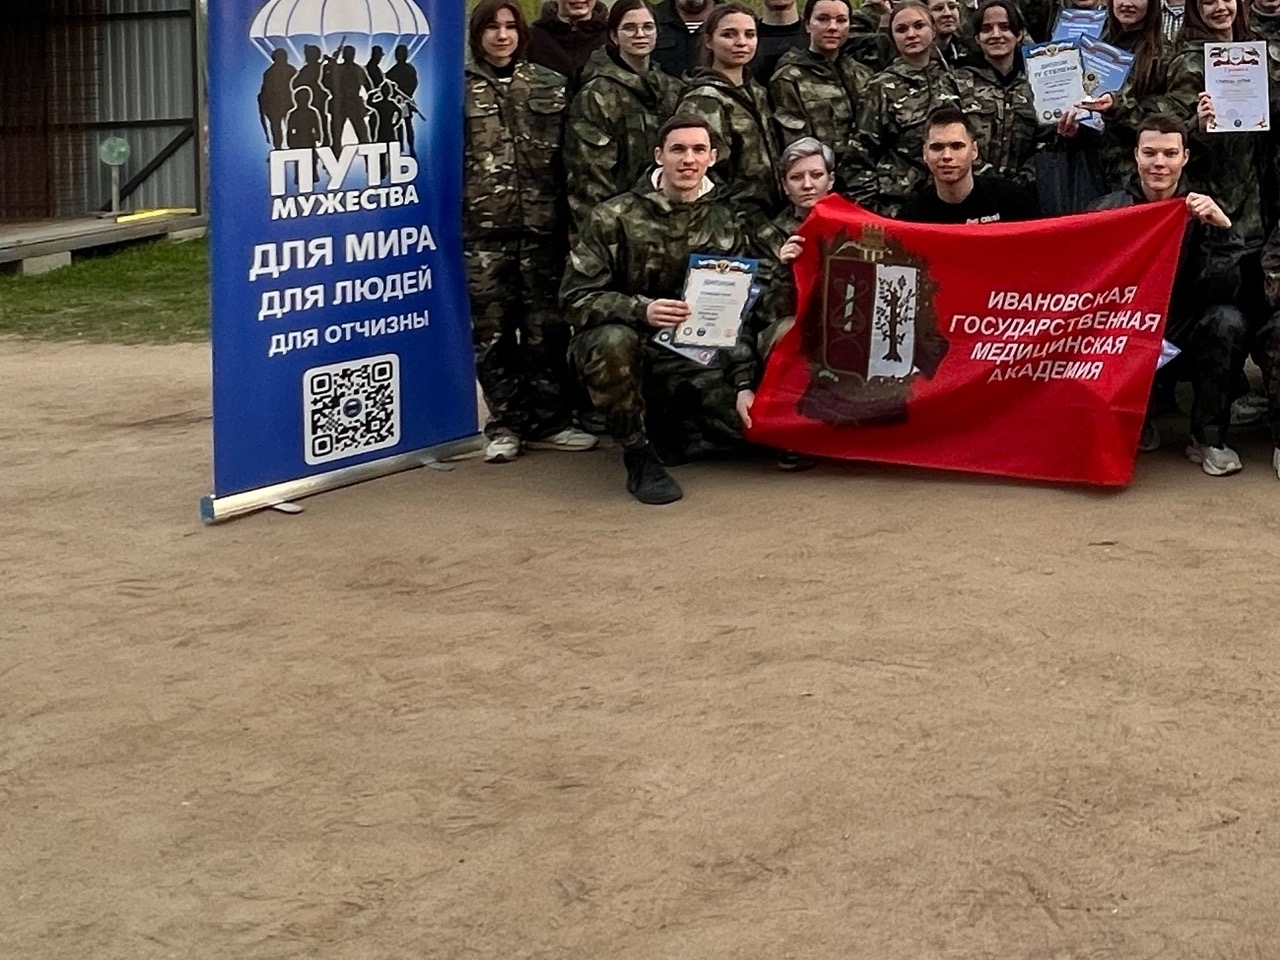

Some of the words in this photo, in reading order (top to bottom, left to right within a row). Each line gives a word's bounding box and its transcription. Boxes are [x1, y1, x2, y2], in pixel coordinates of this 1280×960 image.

[269, 141, 419, 197] ПУТЬ
[271, 185, 420, 221] МУЖЕСТВА
[248, 236, 333, 282] ДЛЯ
[345, 224, 437, 263] МИРА
[257, 284, 325, 322] ДЛЯ
[332, 264, 433, 306] ЛЮДЕЙ
[987, 285, 1138, 312] ИВАНОВСКАЯ
[268, 328, 319, 358] ДЛЯ
[324, 310, 430, 344] ОТЧИЗНЫ
[949, 310, 1162, 340] ГОСУДАРСТВЕННАЯ
[970, 336, 1128, 365] МЕДИЦИНСКАЯ
[986, 360, 1105, 385] АКАДЕМИЯ
